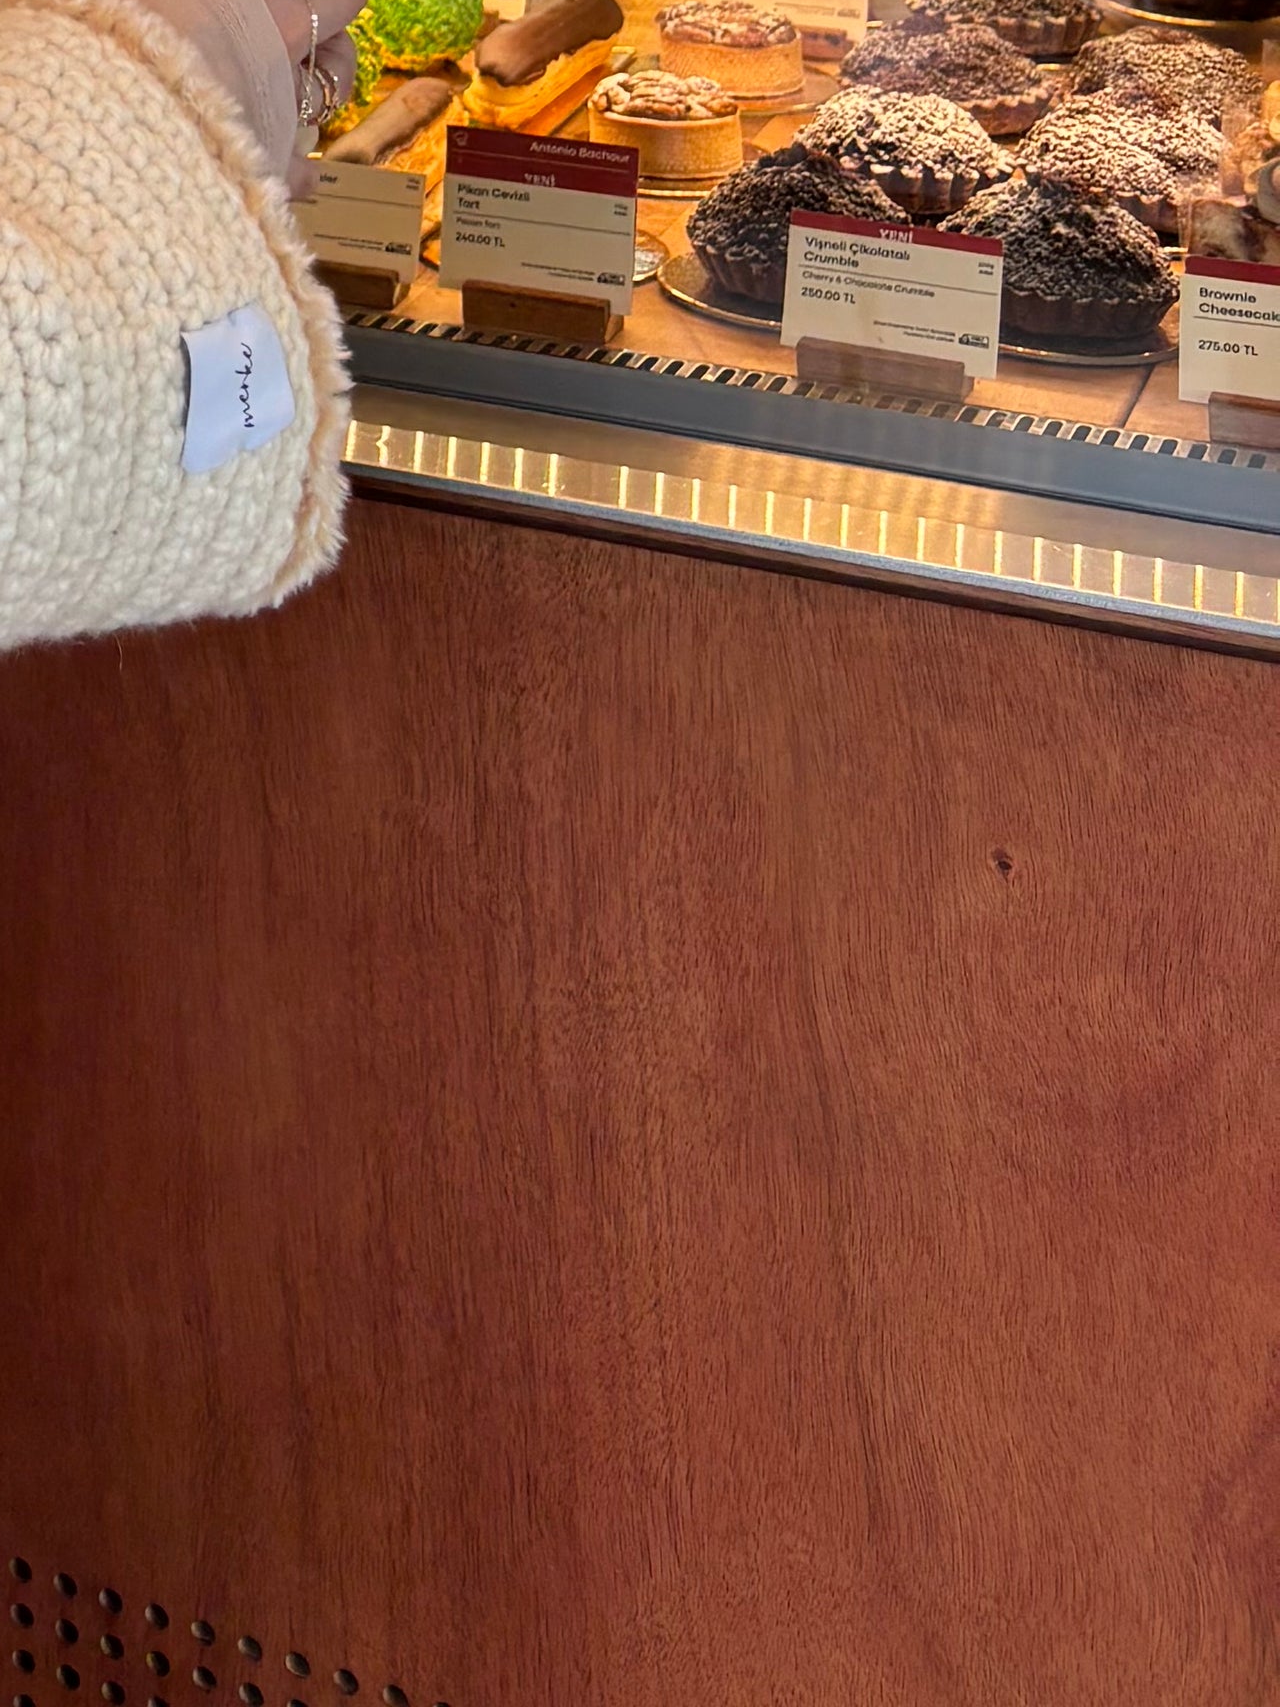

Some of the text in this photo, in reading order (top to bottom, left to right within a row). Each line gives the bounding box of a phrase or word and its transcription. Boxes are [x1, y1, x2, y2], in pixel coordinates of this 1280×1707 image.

[528, 140, 631, 164] Antonio Bachour
[456, 183, 531, 202] Pikan Cevizli
[457, 198, 482, 210] Tart
[493, 235, 507, 248] TL
[879, 227, 915, 244] YENİ
[804, 236, 911, 262] Vişneli Çikolatalı
[803, 250, 860, 269] Crumble
[801, 269, 836, 284] Cherry
[893, 283, 936, 298] Crumble
[800, 286, 857, 305] 250.00 TL
[1199, 286, 1258, 304] Brownie
[1198, 302, 1280, 322] Cheesecak
[1198, 339, 1259, 357] 275.00 TL
